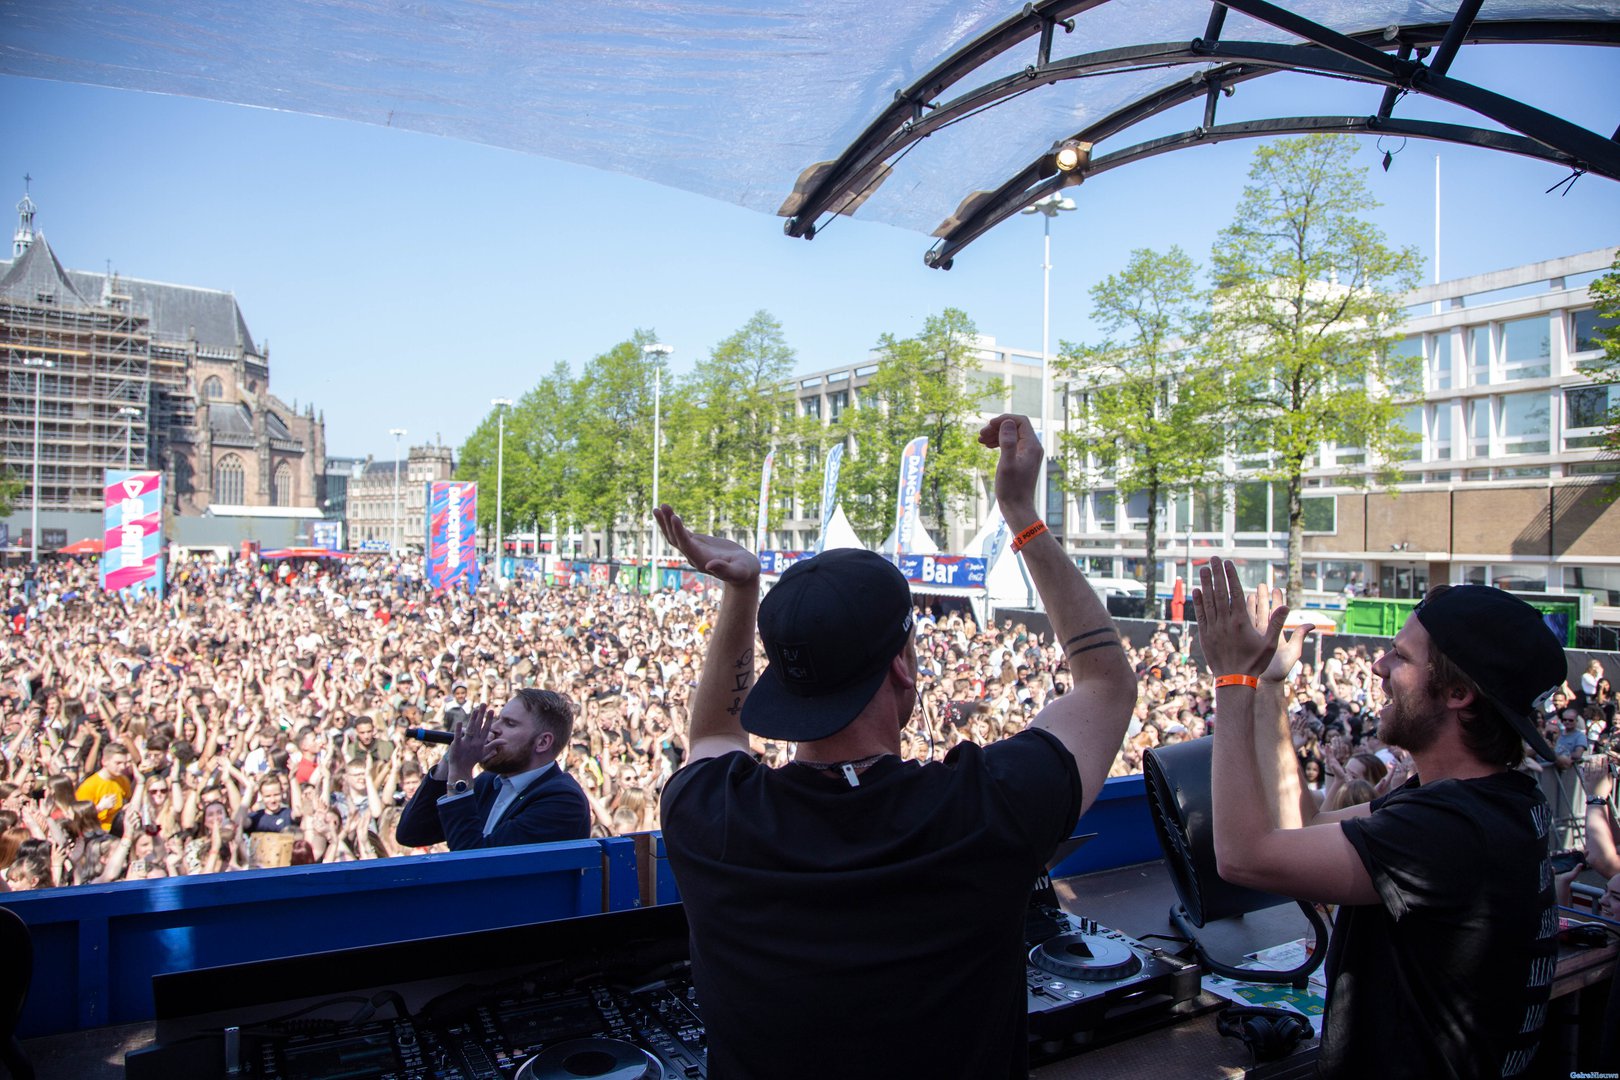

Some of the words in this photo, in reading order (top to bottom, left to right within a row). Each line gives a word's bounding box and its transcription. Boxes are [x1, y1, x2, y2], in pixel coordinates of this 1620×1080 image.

[447, 486, 461, 572] DANCETOUR
[901, 455, 920, 544] DANCETOUR
[922, 556, 958, 584] Bar
